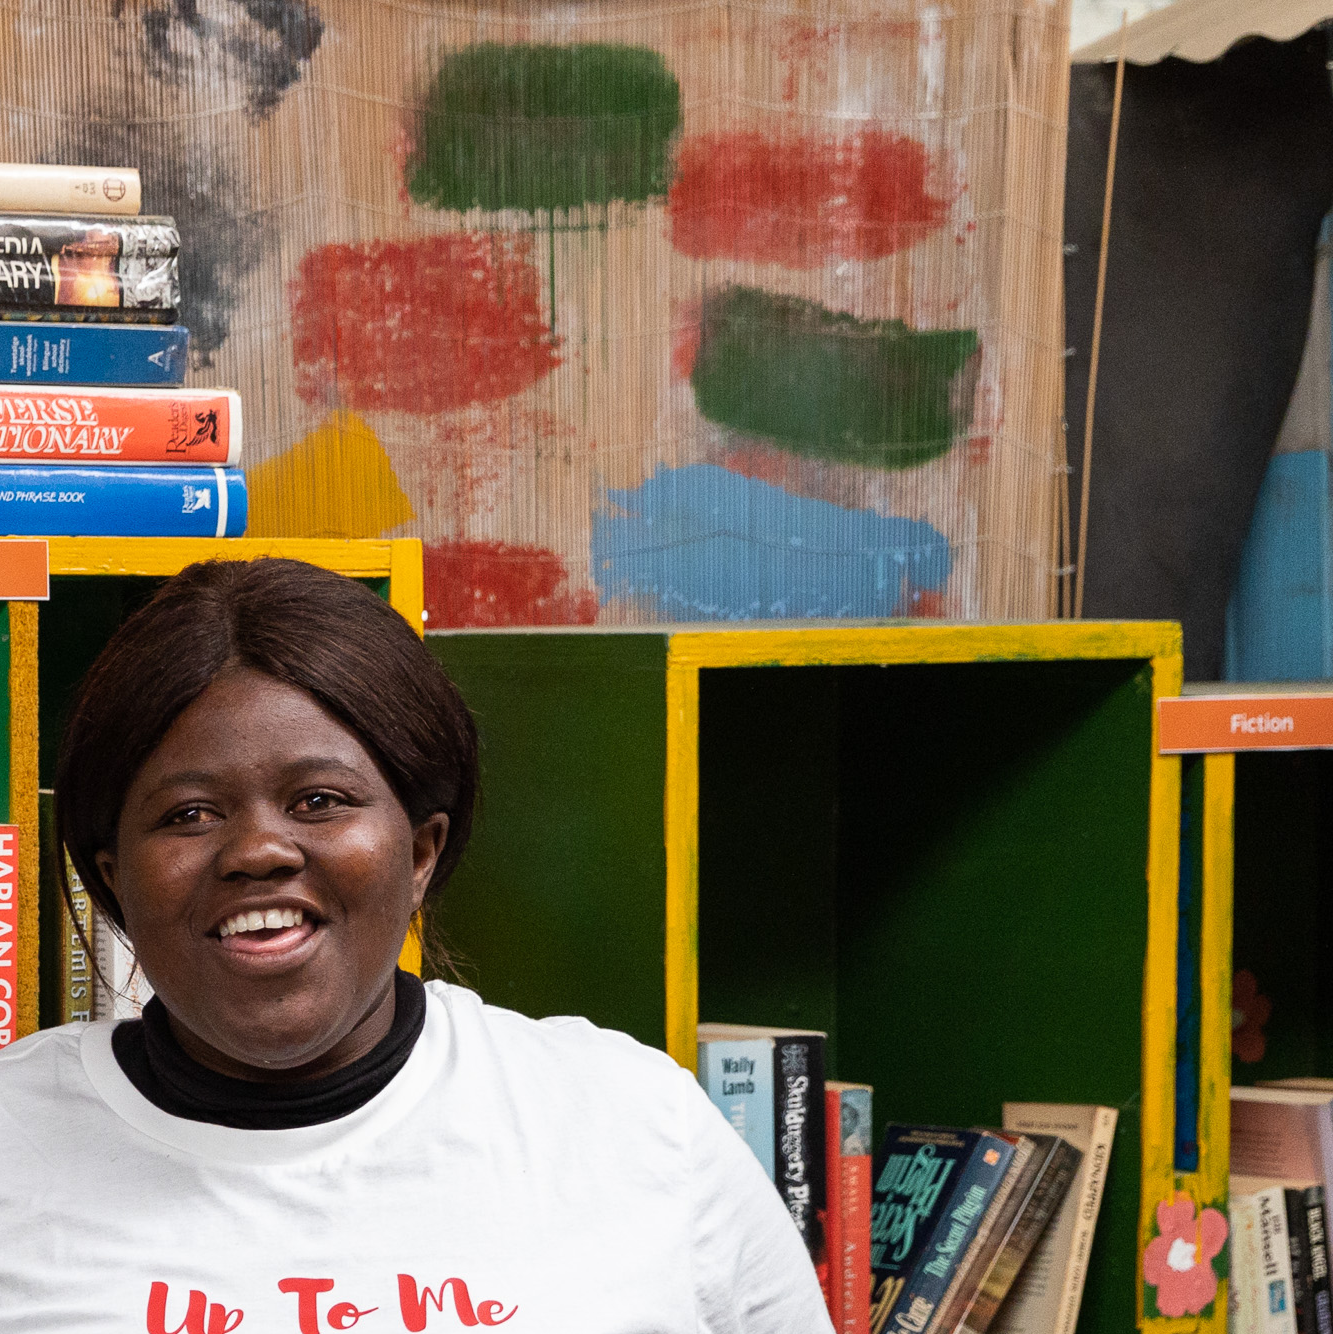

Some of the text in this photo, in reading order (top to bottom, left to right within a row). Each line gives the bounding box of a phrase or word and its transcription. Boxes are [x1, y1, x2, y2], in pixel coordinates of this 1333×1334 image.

[15, 491, 57, 503] PHRASE
[58, 492, 85, 504] BOOK
[1231, 713, 1294, 734] Fiction
[721, 1056, 755, 1076] Wally
[721, 1078, 755, 1096] Lamb
[397, 1274, 519, 1334] Me
